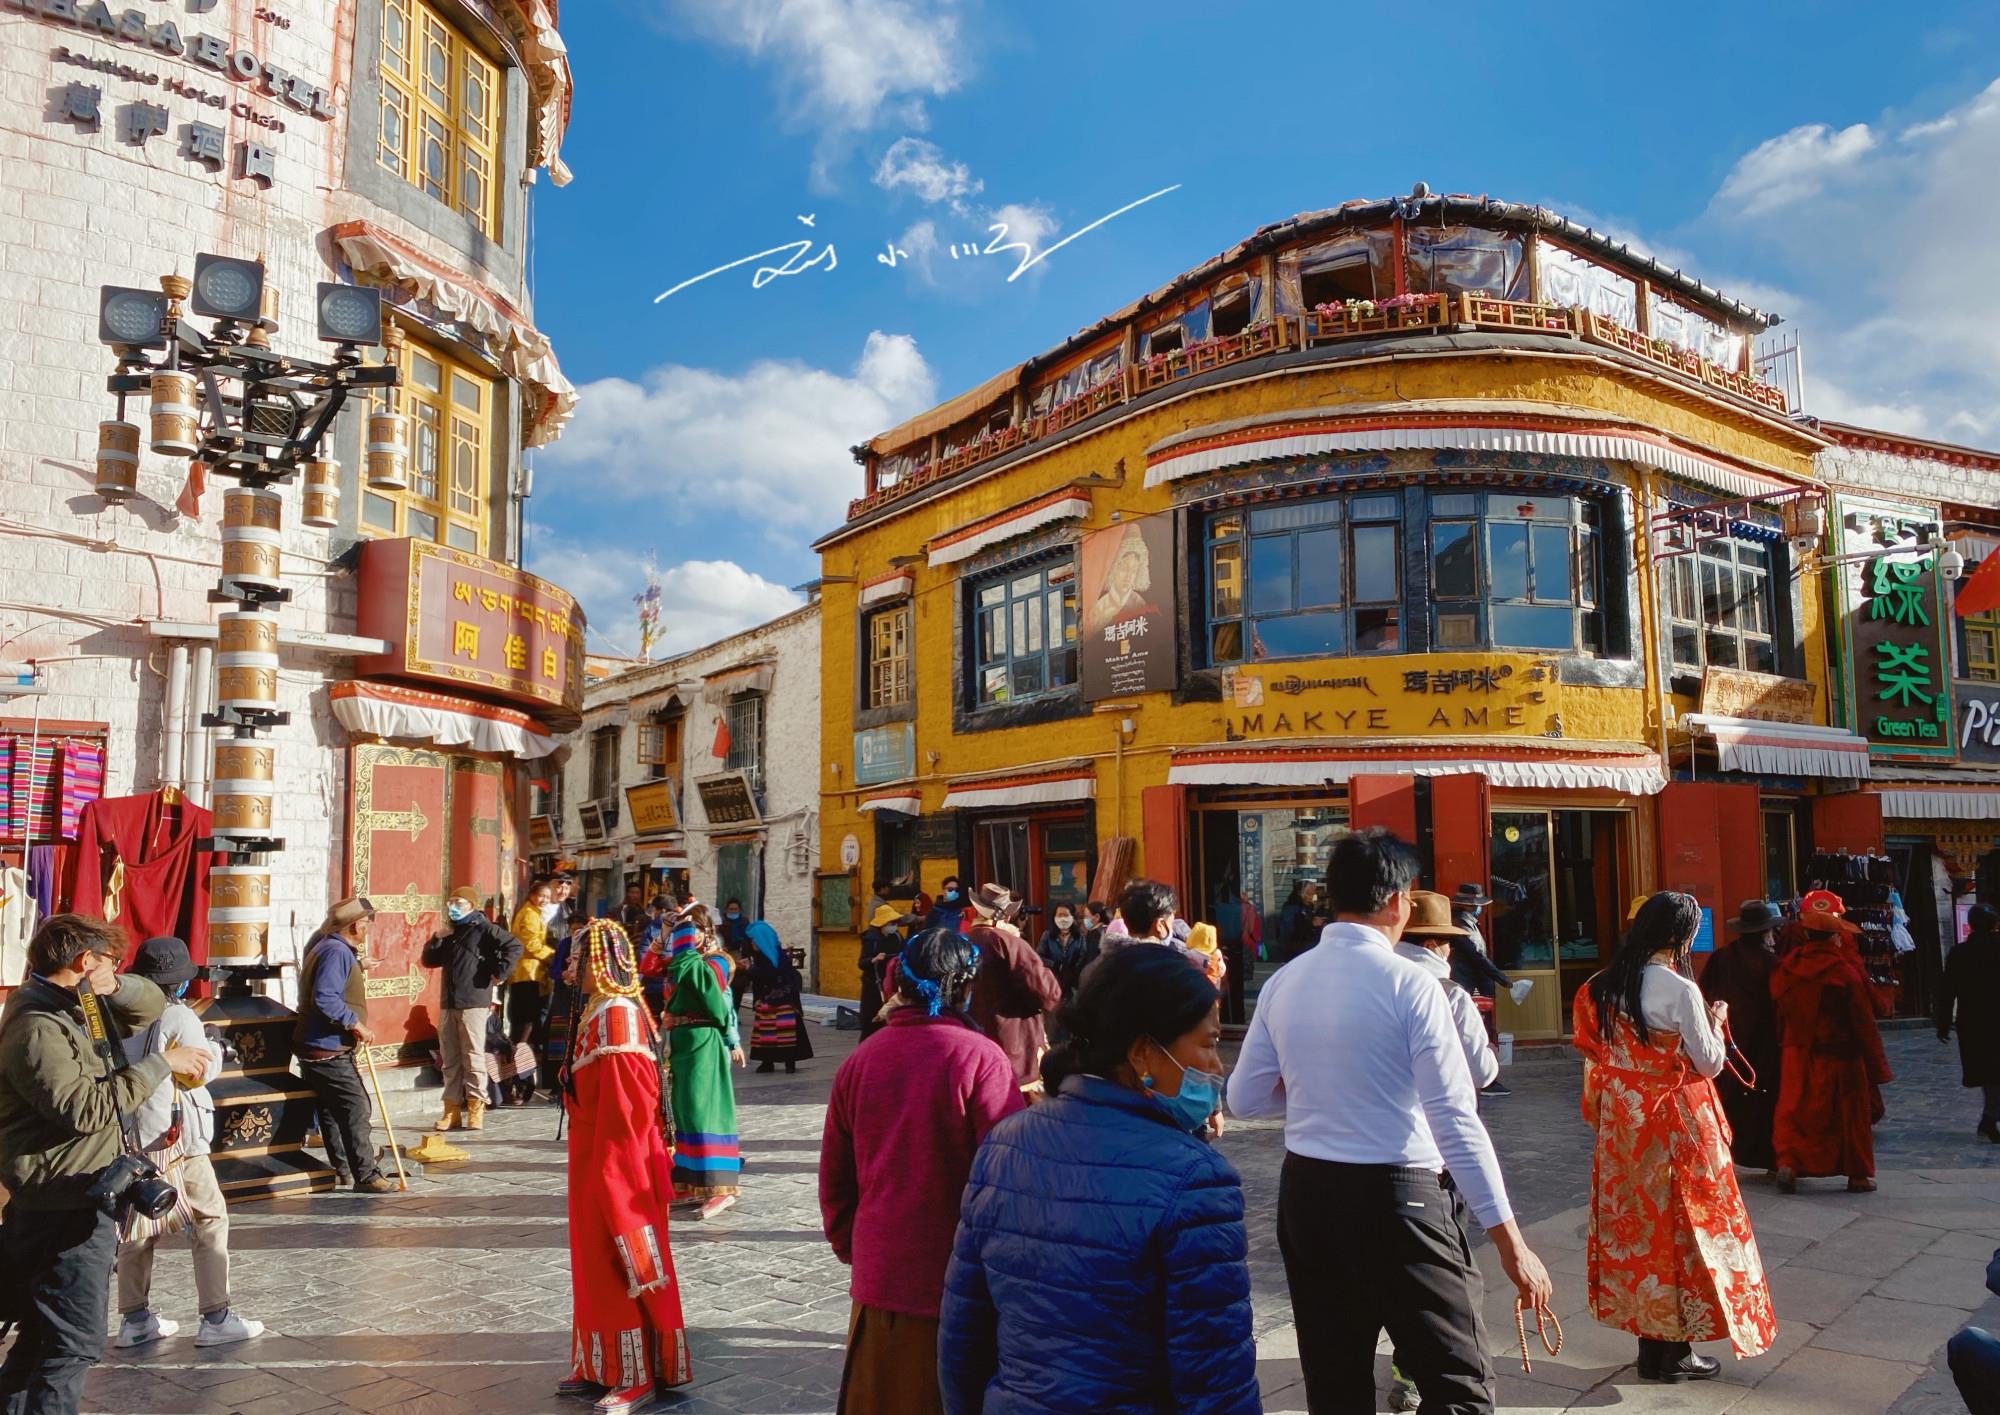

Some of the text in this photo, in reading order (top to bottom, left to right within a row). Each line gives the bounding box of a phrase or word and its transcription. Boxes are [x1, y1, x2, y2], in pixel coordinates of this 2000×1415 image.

[255, 7, 290, 30] 2016
[0, 0, 337, 120] HASA HOTEL
[166, 77, 226, 110] Hotel
[231, 103, 286, 133] Chain
[1242, 706, 1526, 734] MAKYE AME
[1877, 716, 1938, 738] Green Tea
[91, 1015, 103, 1039] Nikon
